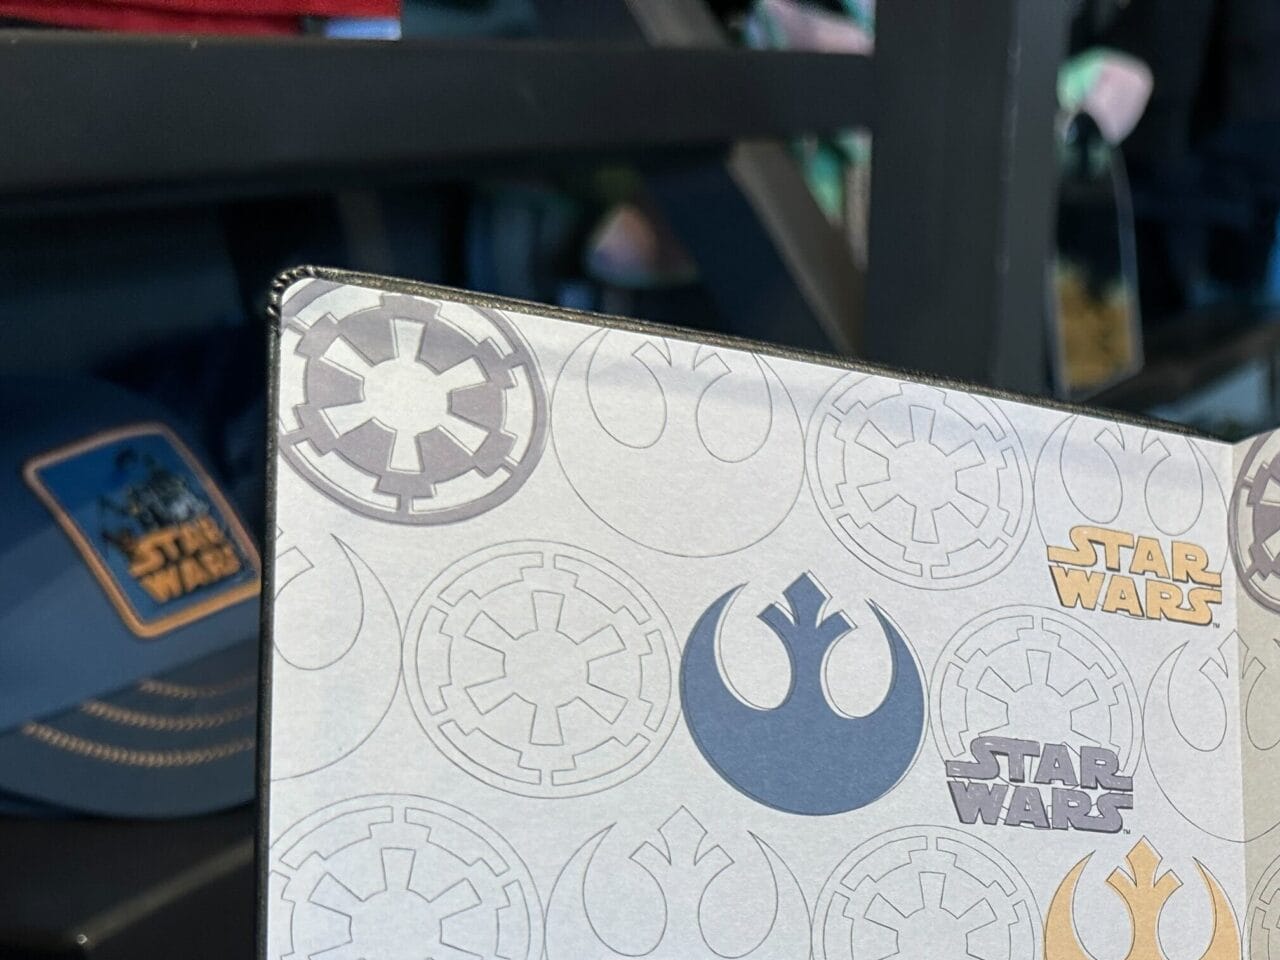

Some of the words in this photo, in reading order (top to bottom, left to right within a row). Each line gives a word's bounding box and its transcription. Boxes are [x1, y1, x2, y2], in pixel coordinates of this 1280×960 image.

[128, 515, 222, 578] STAR
[1047, 525, 1222, 587] STAR
[1049, 565, 1222, 627] WARS
[945, 736, 1134, 791] STAR
[947, 780, 1134, 834] WARS
